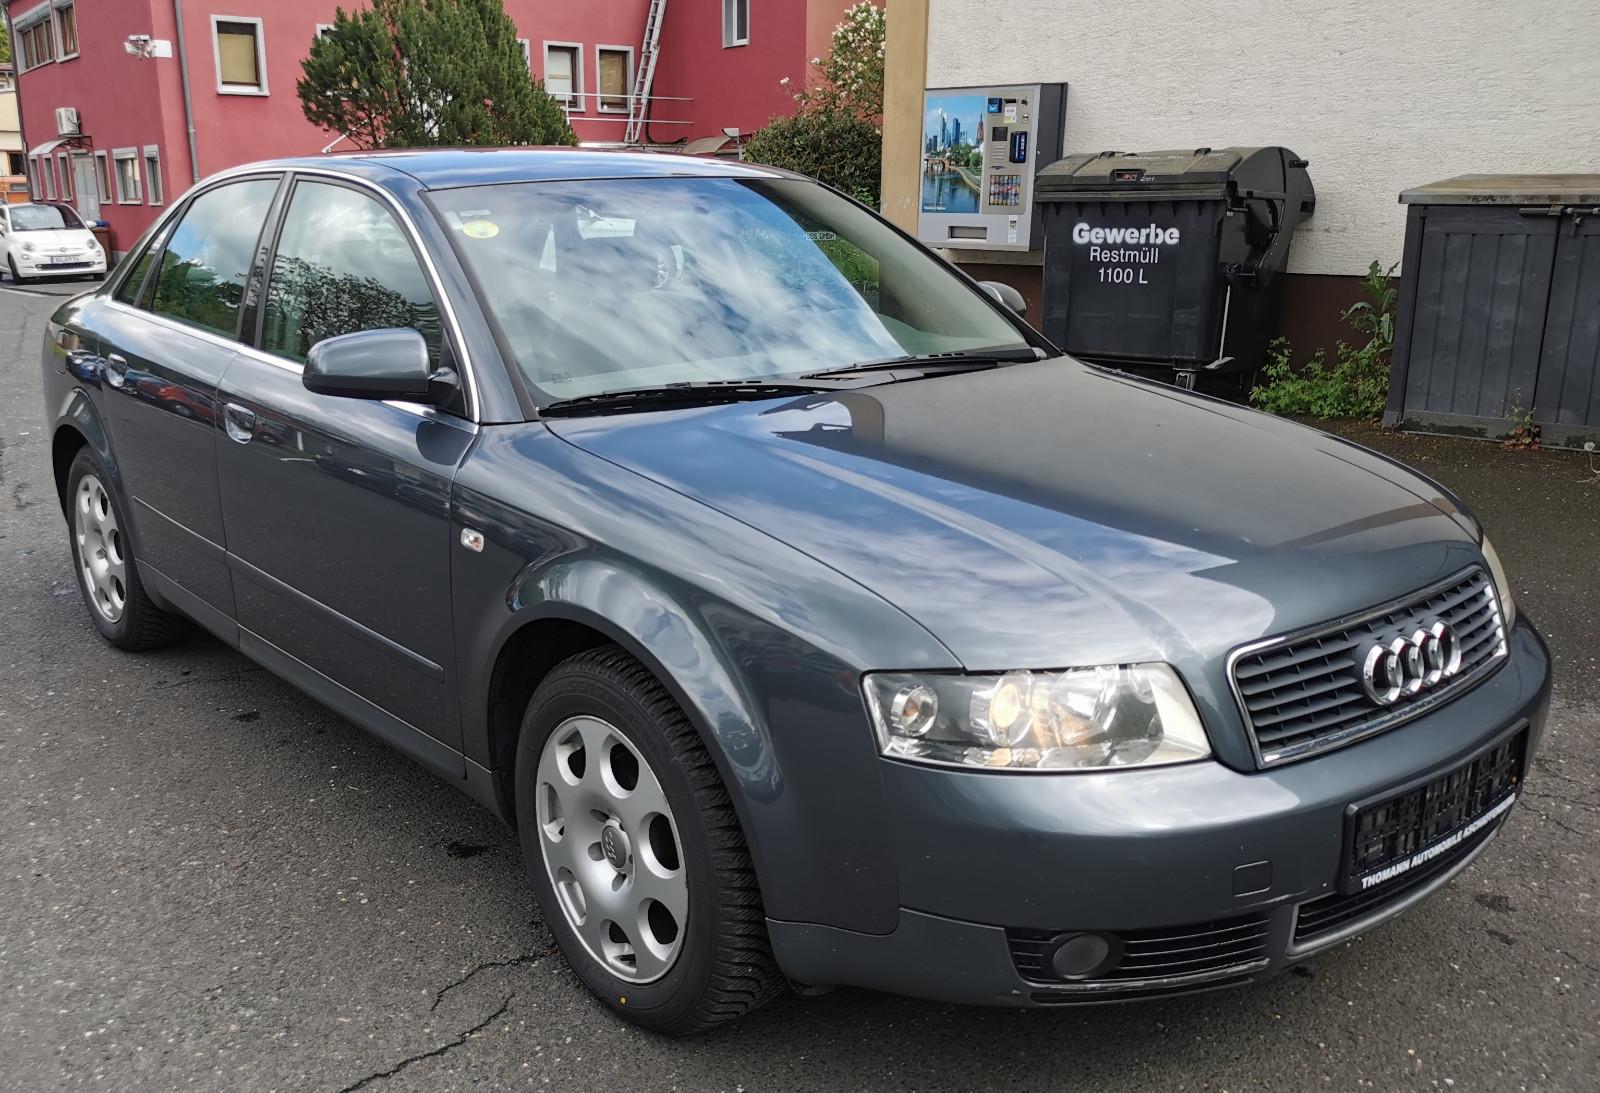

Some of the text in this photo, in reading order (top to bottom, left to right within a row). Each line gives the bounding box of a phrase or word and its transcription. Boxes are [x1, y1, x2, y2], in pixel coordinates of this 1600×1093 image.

[1072, 222, 1180, 245] Gewerbe
[1089, 246, 1159, 264] Restmüll
[1098, 267, 1149, 284] 1100 L
[1361, 859, 1411, 890] THOMANN
[1411, 829, 1463, 868] AUTOMOBILE
